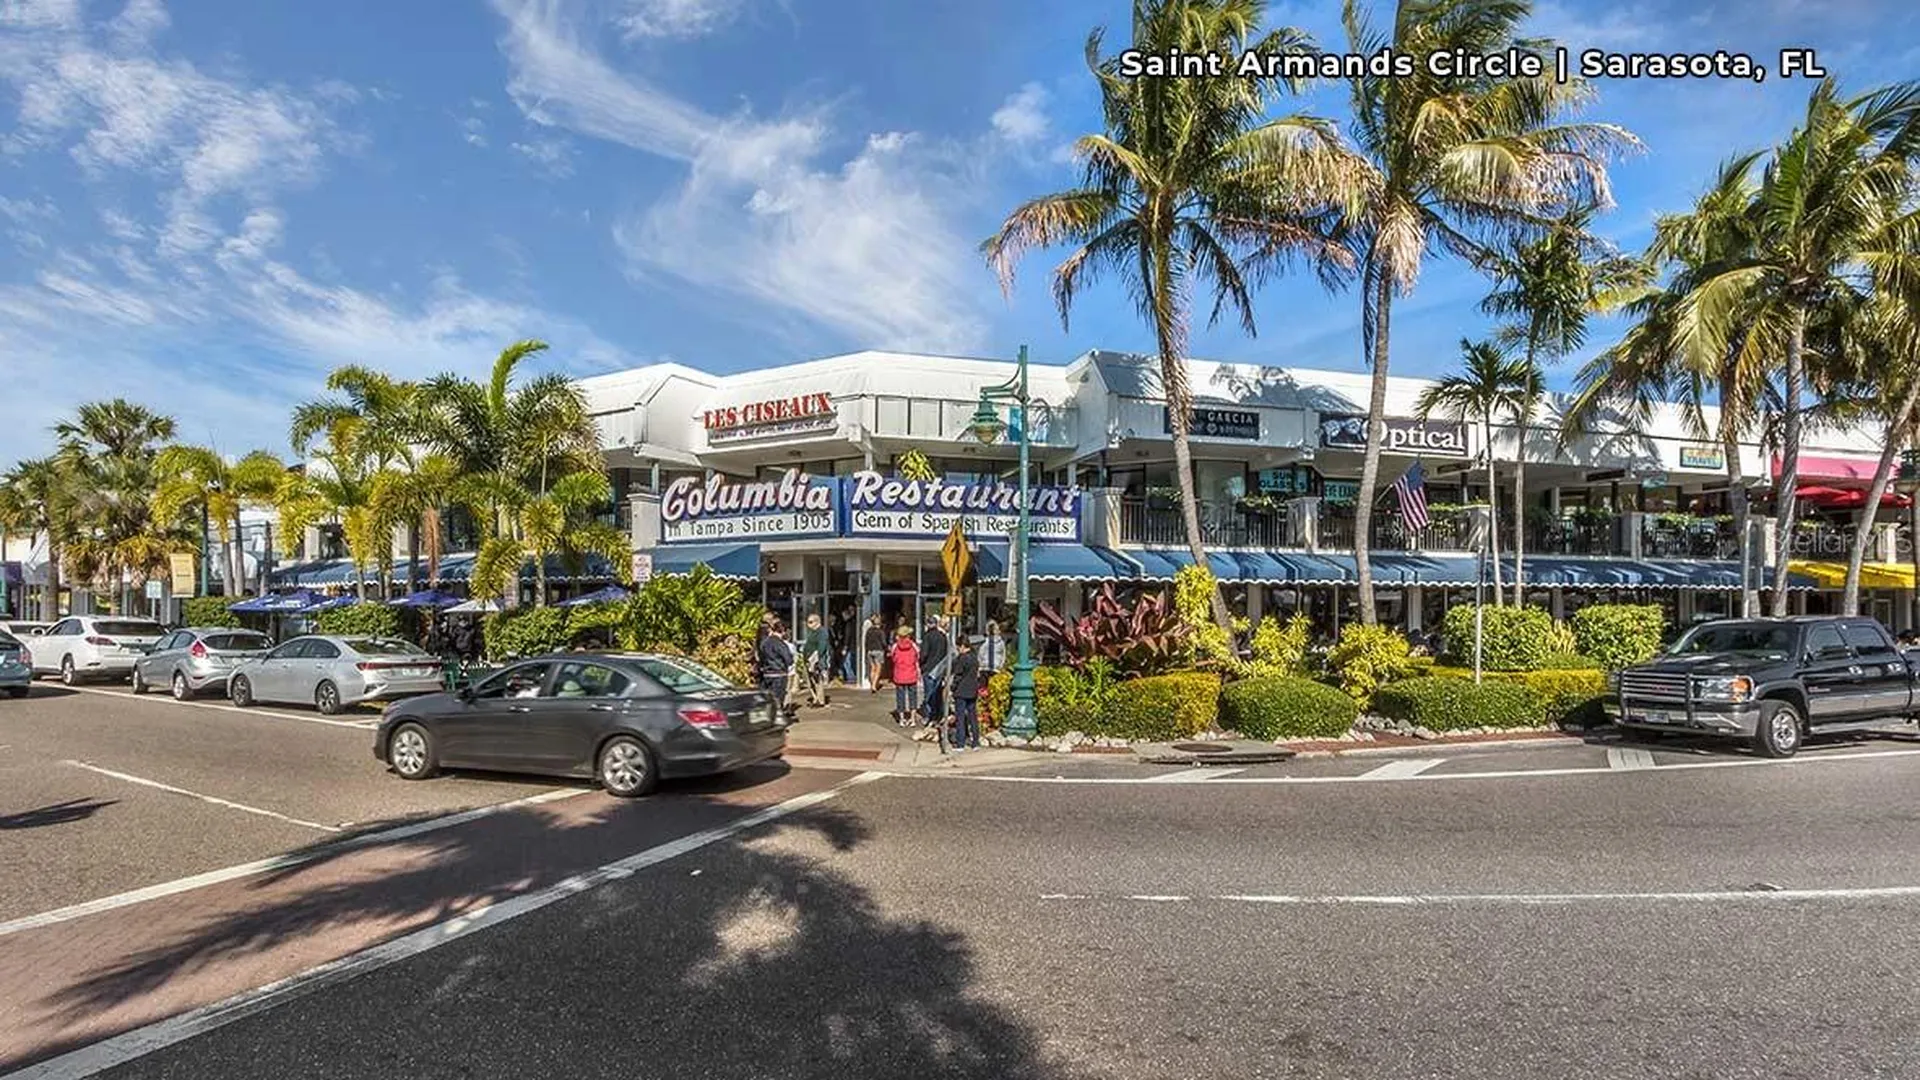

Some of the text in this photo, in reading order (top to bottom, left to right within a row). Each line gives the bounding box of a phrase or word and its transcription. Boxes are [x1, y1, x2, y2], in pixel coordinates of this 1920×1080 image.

[704, 392, 833, 429] LES CISEAUX
[1207, 412, 1253, 424] GARCIA
[1362, 419, 1466, 449] Optical
[662, 467, 830, 522] Columbia
[851, 471, 1081, 513] Restaurant
[668, 513, 831, 538] In Tampa Since 1905
[855, 510, 892, 528] Gem
[898, 513, 913, 529] of
[987, 516, 1071, 534] Resturants
